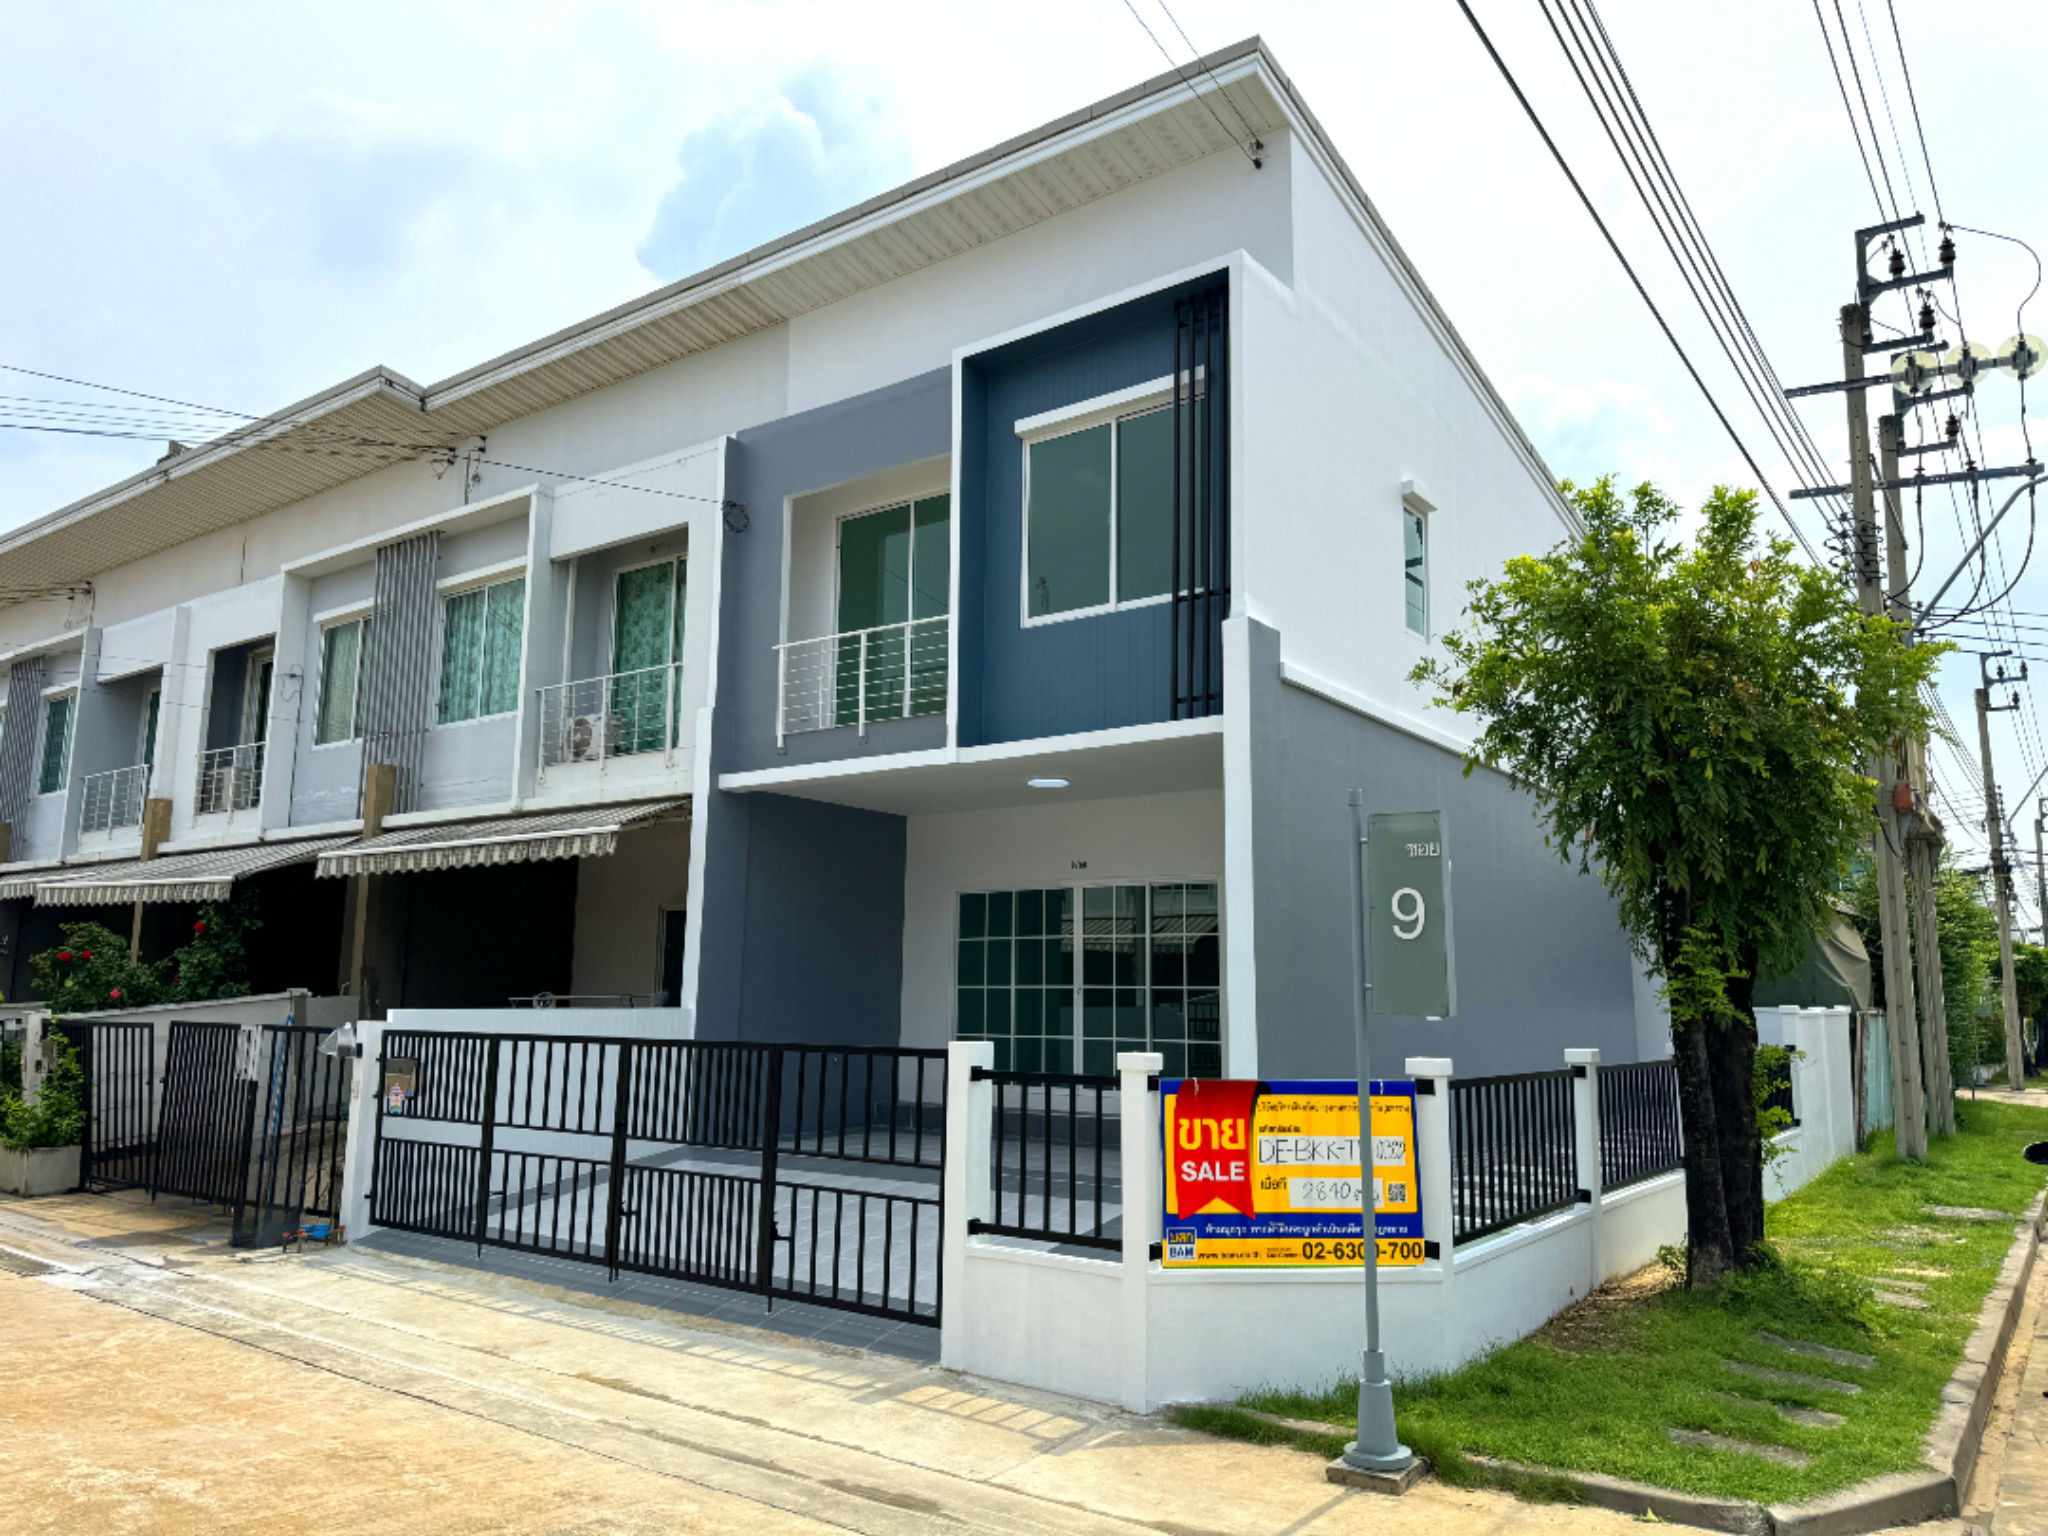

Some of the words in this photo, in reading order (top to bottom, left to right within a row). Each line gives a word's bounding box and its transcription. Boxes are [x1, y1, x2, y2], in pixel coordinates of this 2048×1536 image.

[1405, 842, 1440, 857] ซอย
[1391, 887, 1425, 940] 9
[1178, 1117, 1246, 1151] ขาย
[1180, 1160, 1246, 1182] SALE
